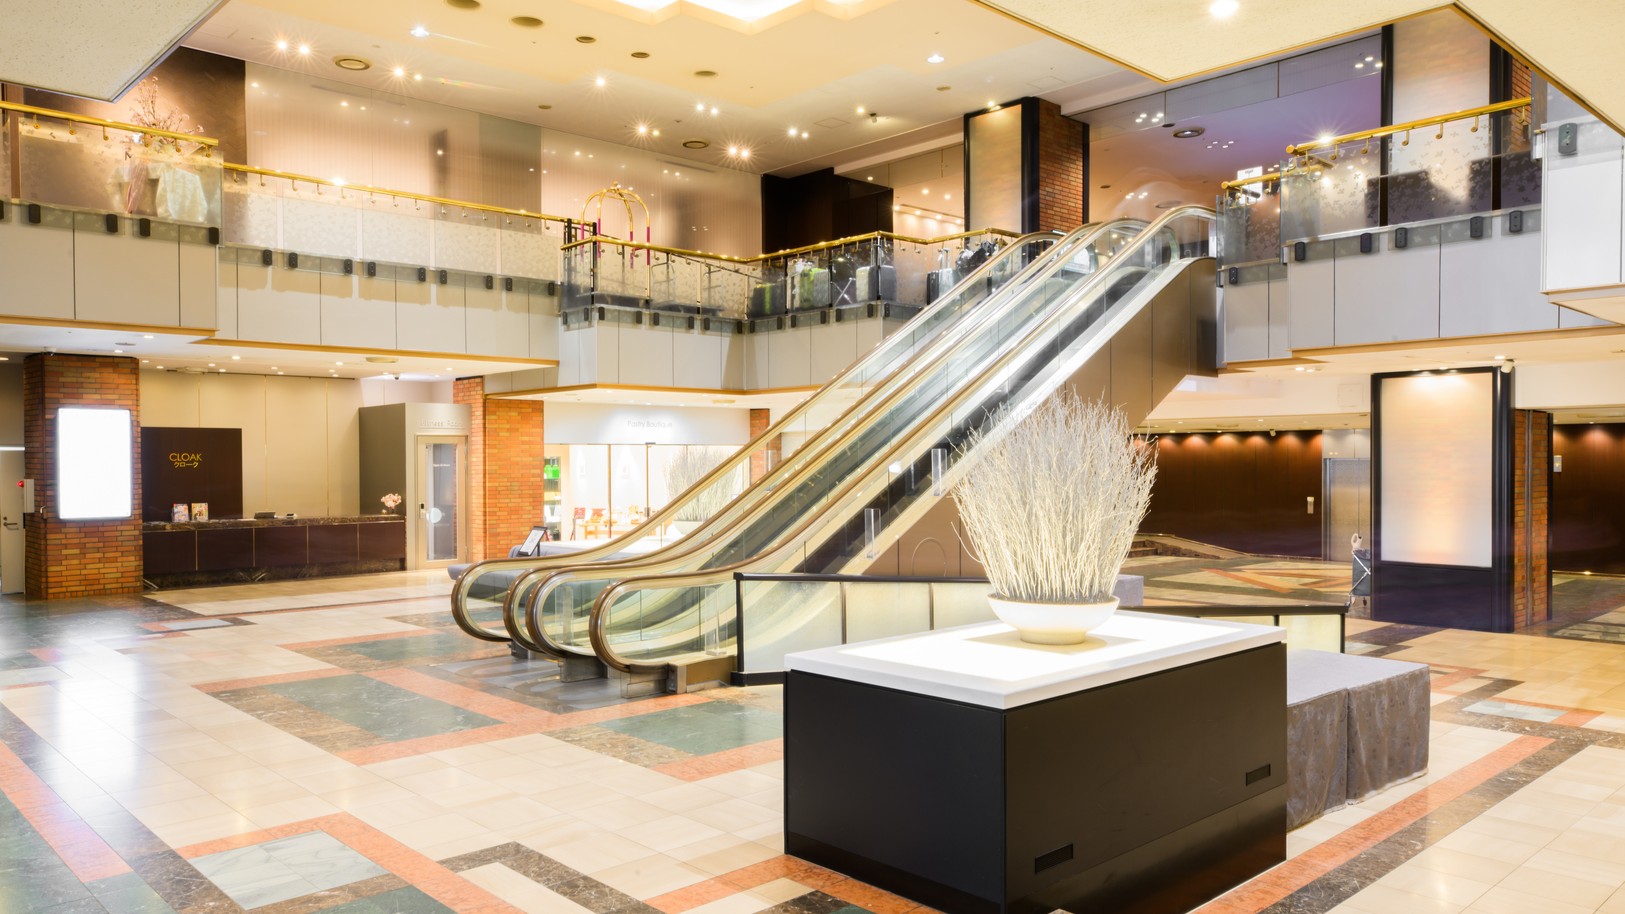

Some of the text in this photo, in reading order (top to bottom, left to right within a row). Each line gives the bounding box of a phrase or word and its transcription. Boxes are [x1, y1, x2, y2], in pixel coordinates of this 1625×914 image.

[627, 420, 672, 428] Pastry Boutique
[169, 453, 202, 461] CLOAK
